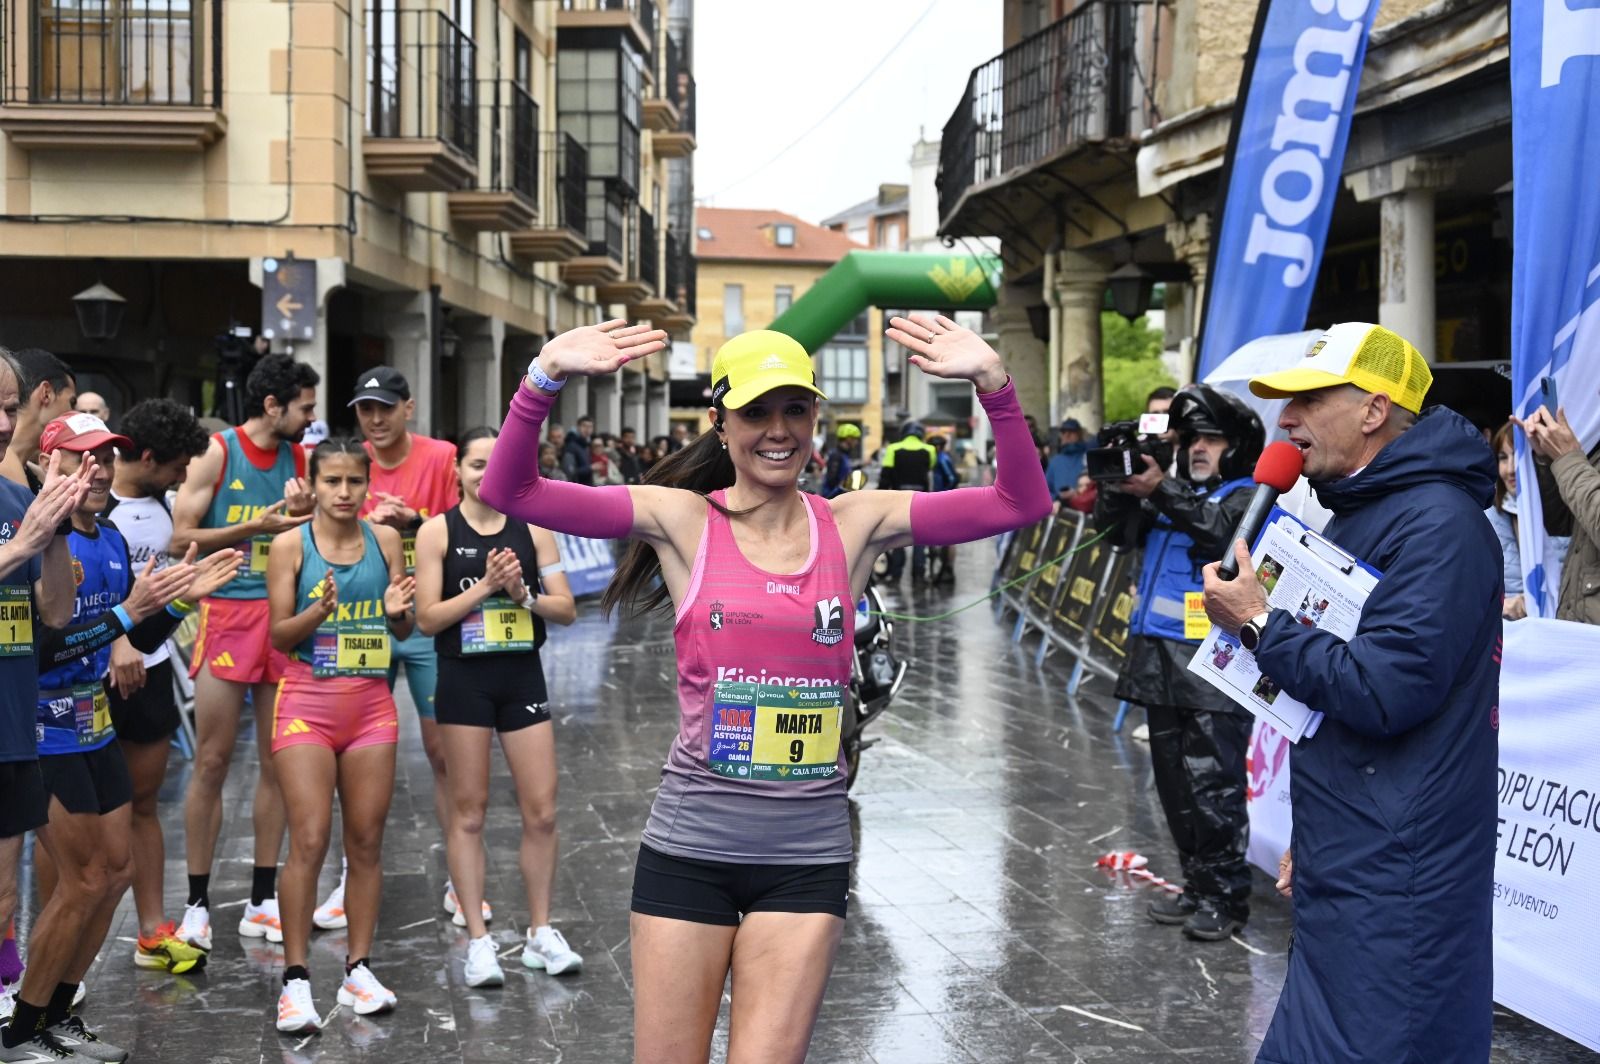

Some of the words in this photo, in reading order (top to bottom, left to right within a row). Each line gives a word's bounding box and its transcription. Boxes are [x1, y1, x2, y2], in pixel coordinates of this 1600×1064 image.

[1188, 599, 1205, 609] 10
[0, 606, 9, 620] EL
[500, 612, 517, 624] LUCI
[725, 611, 763, 620] DIPUTACIÓN
[735, 617, 752, 625] LEÓN
[10, 625, 15, 642] 1
[505, 627, 513, 639] 6
[344, 637, 383, 650] TISALEMA
[358, 653, 367, 666] 4
[717, 691, 753, 701] Telenauto
[800, 692, 818, 700] CAJA
[819, 690, 841, 699] RURAL
[719, 708, 752, 728] 10K
[775, 713, 823, 735] MARTA
[714, 725, 742, 733] CIUDAD
[713, 732, 753, 741] ASTORGA
[737, 741, 750, 751] 26
[789, 739, 805, 763] 9
[792, 767, 810, 775] CAJA
[1506, 823, 1575, 876] LEÓN
[1504, 885, 1511, 901] Y
[1507, 888, 1559, 920] JUVENTUD
